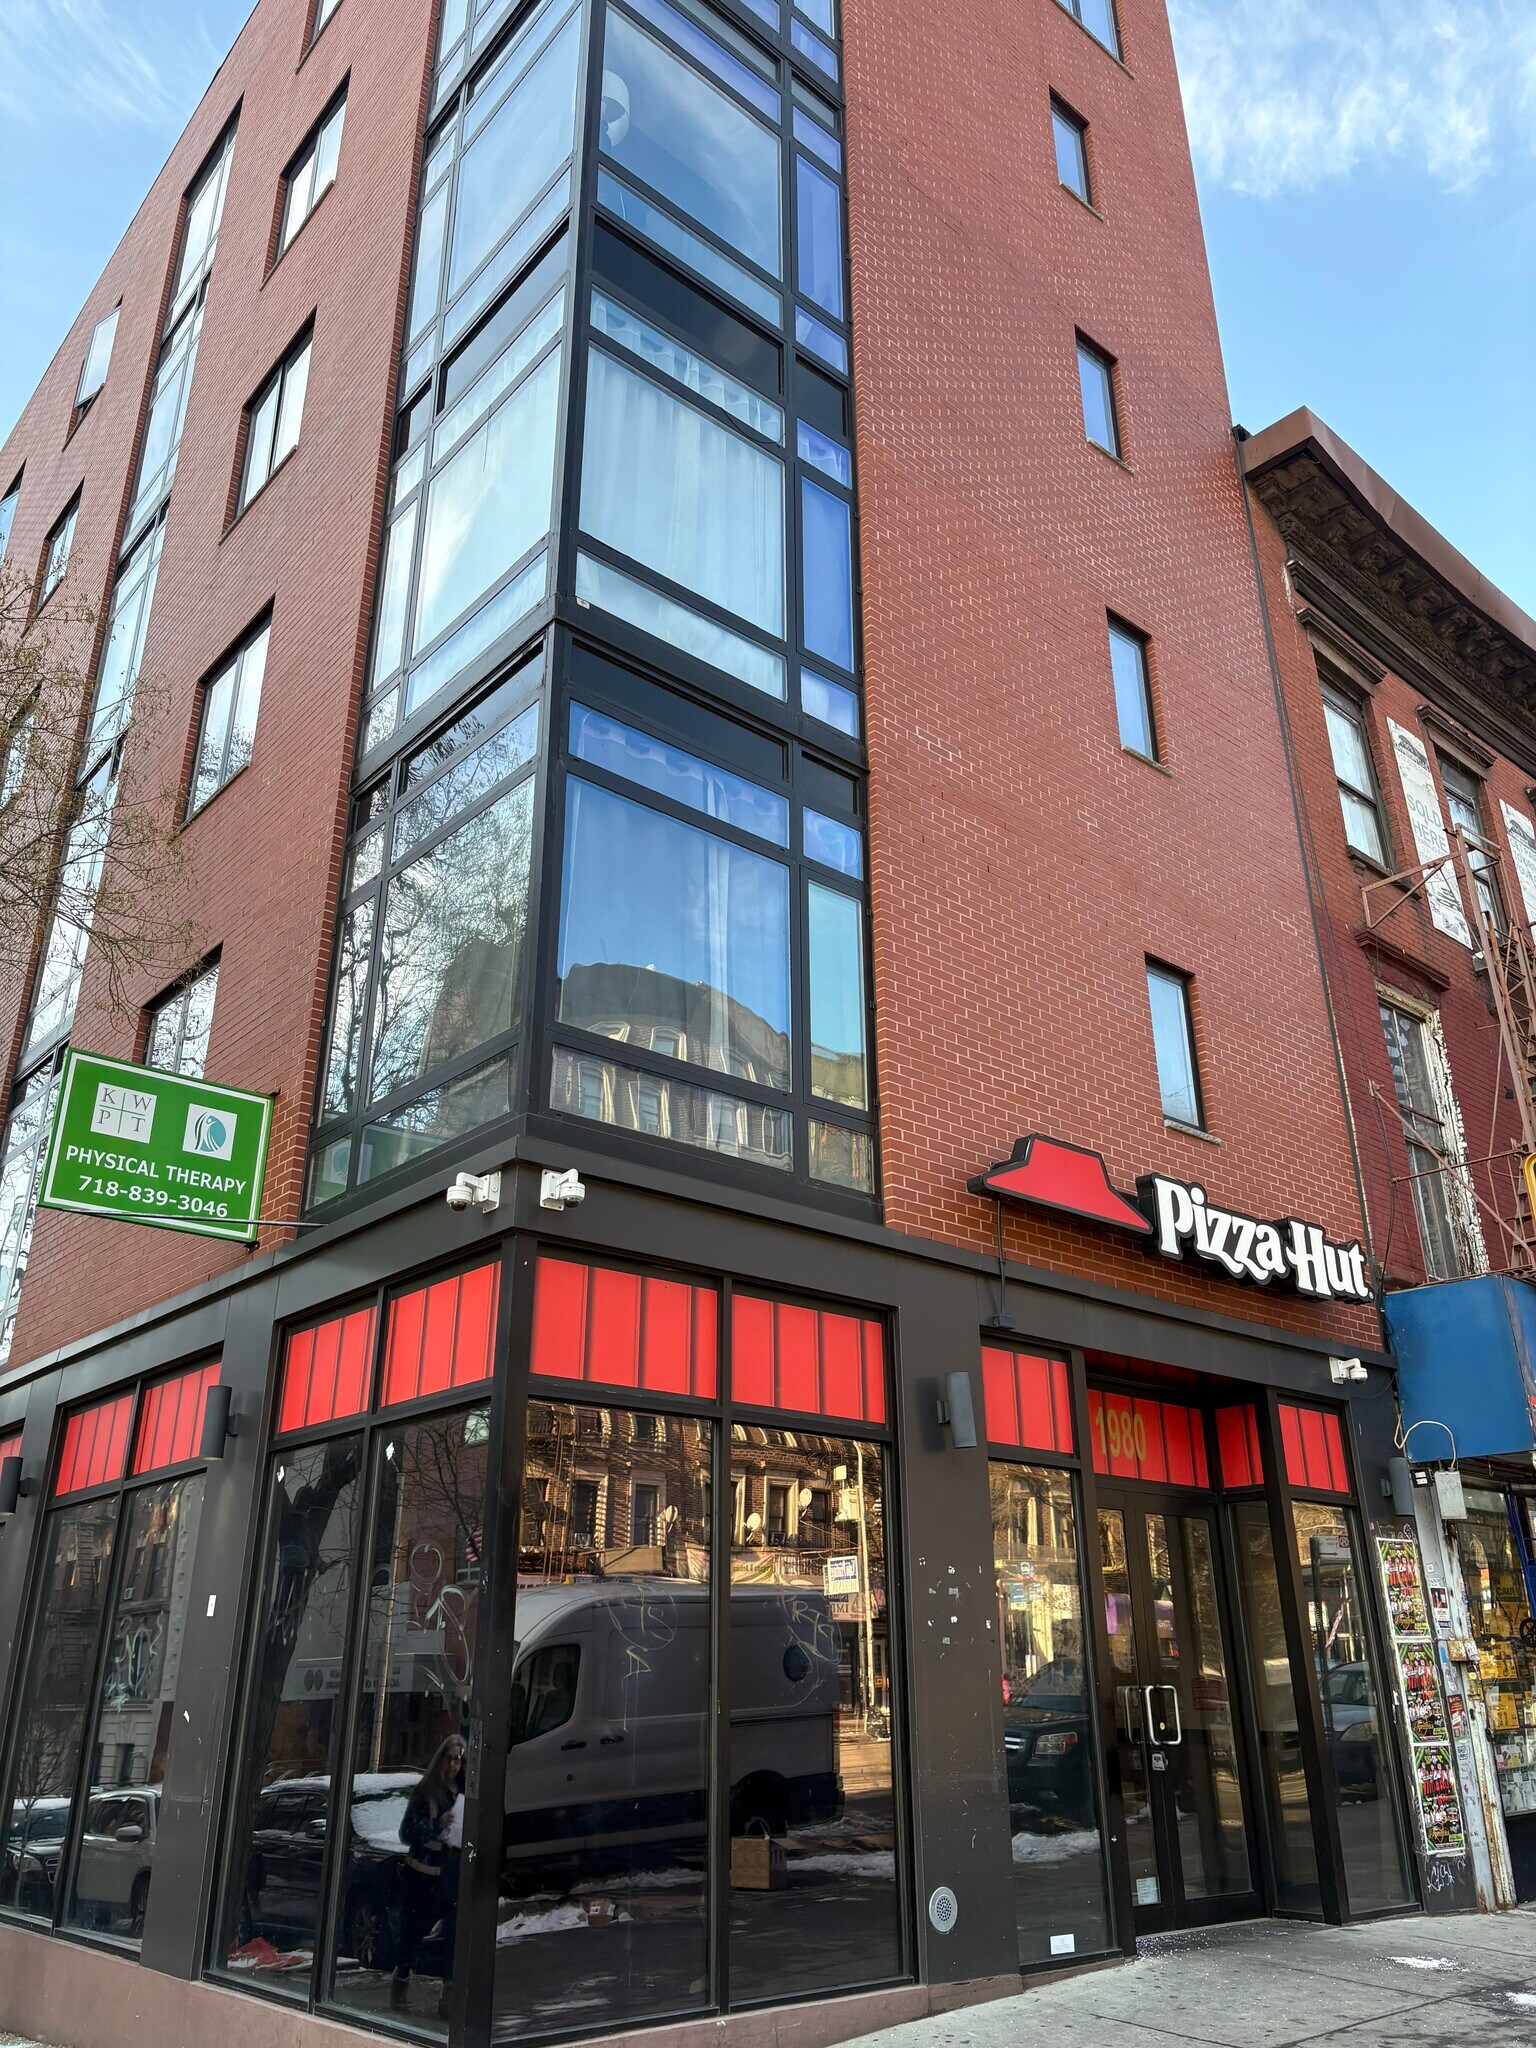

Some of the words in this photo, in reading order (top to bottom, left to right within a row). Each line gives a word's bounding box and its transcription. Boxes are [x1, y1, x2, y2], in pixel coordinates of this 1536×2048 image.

[1407, 794, 1441, 828] SOLD
[1412, 818, 1447, 853] HERE
[101, 1087, 116, 1104] K
[132, 1094, 152, 1111] W
[97, 1109, 111, 1124] P
[131, 1116, 146, 1132] T
[65, 1145, 159, 1178] PHYSICAL
[166, 1165, 246, 1195] THERAPY
[78, 1175, 228, 1217] 718-839-3046
[1154, 1177, 1286, 1280] Pizza
[1286, 1220, 1369, 1297] Hut
[1095, 1407, 1147, 1461] 1980
